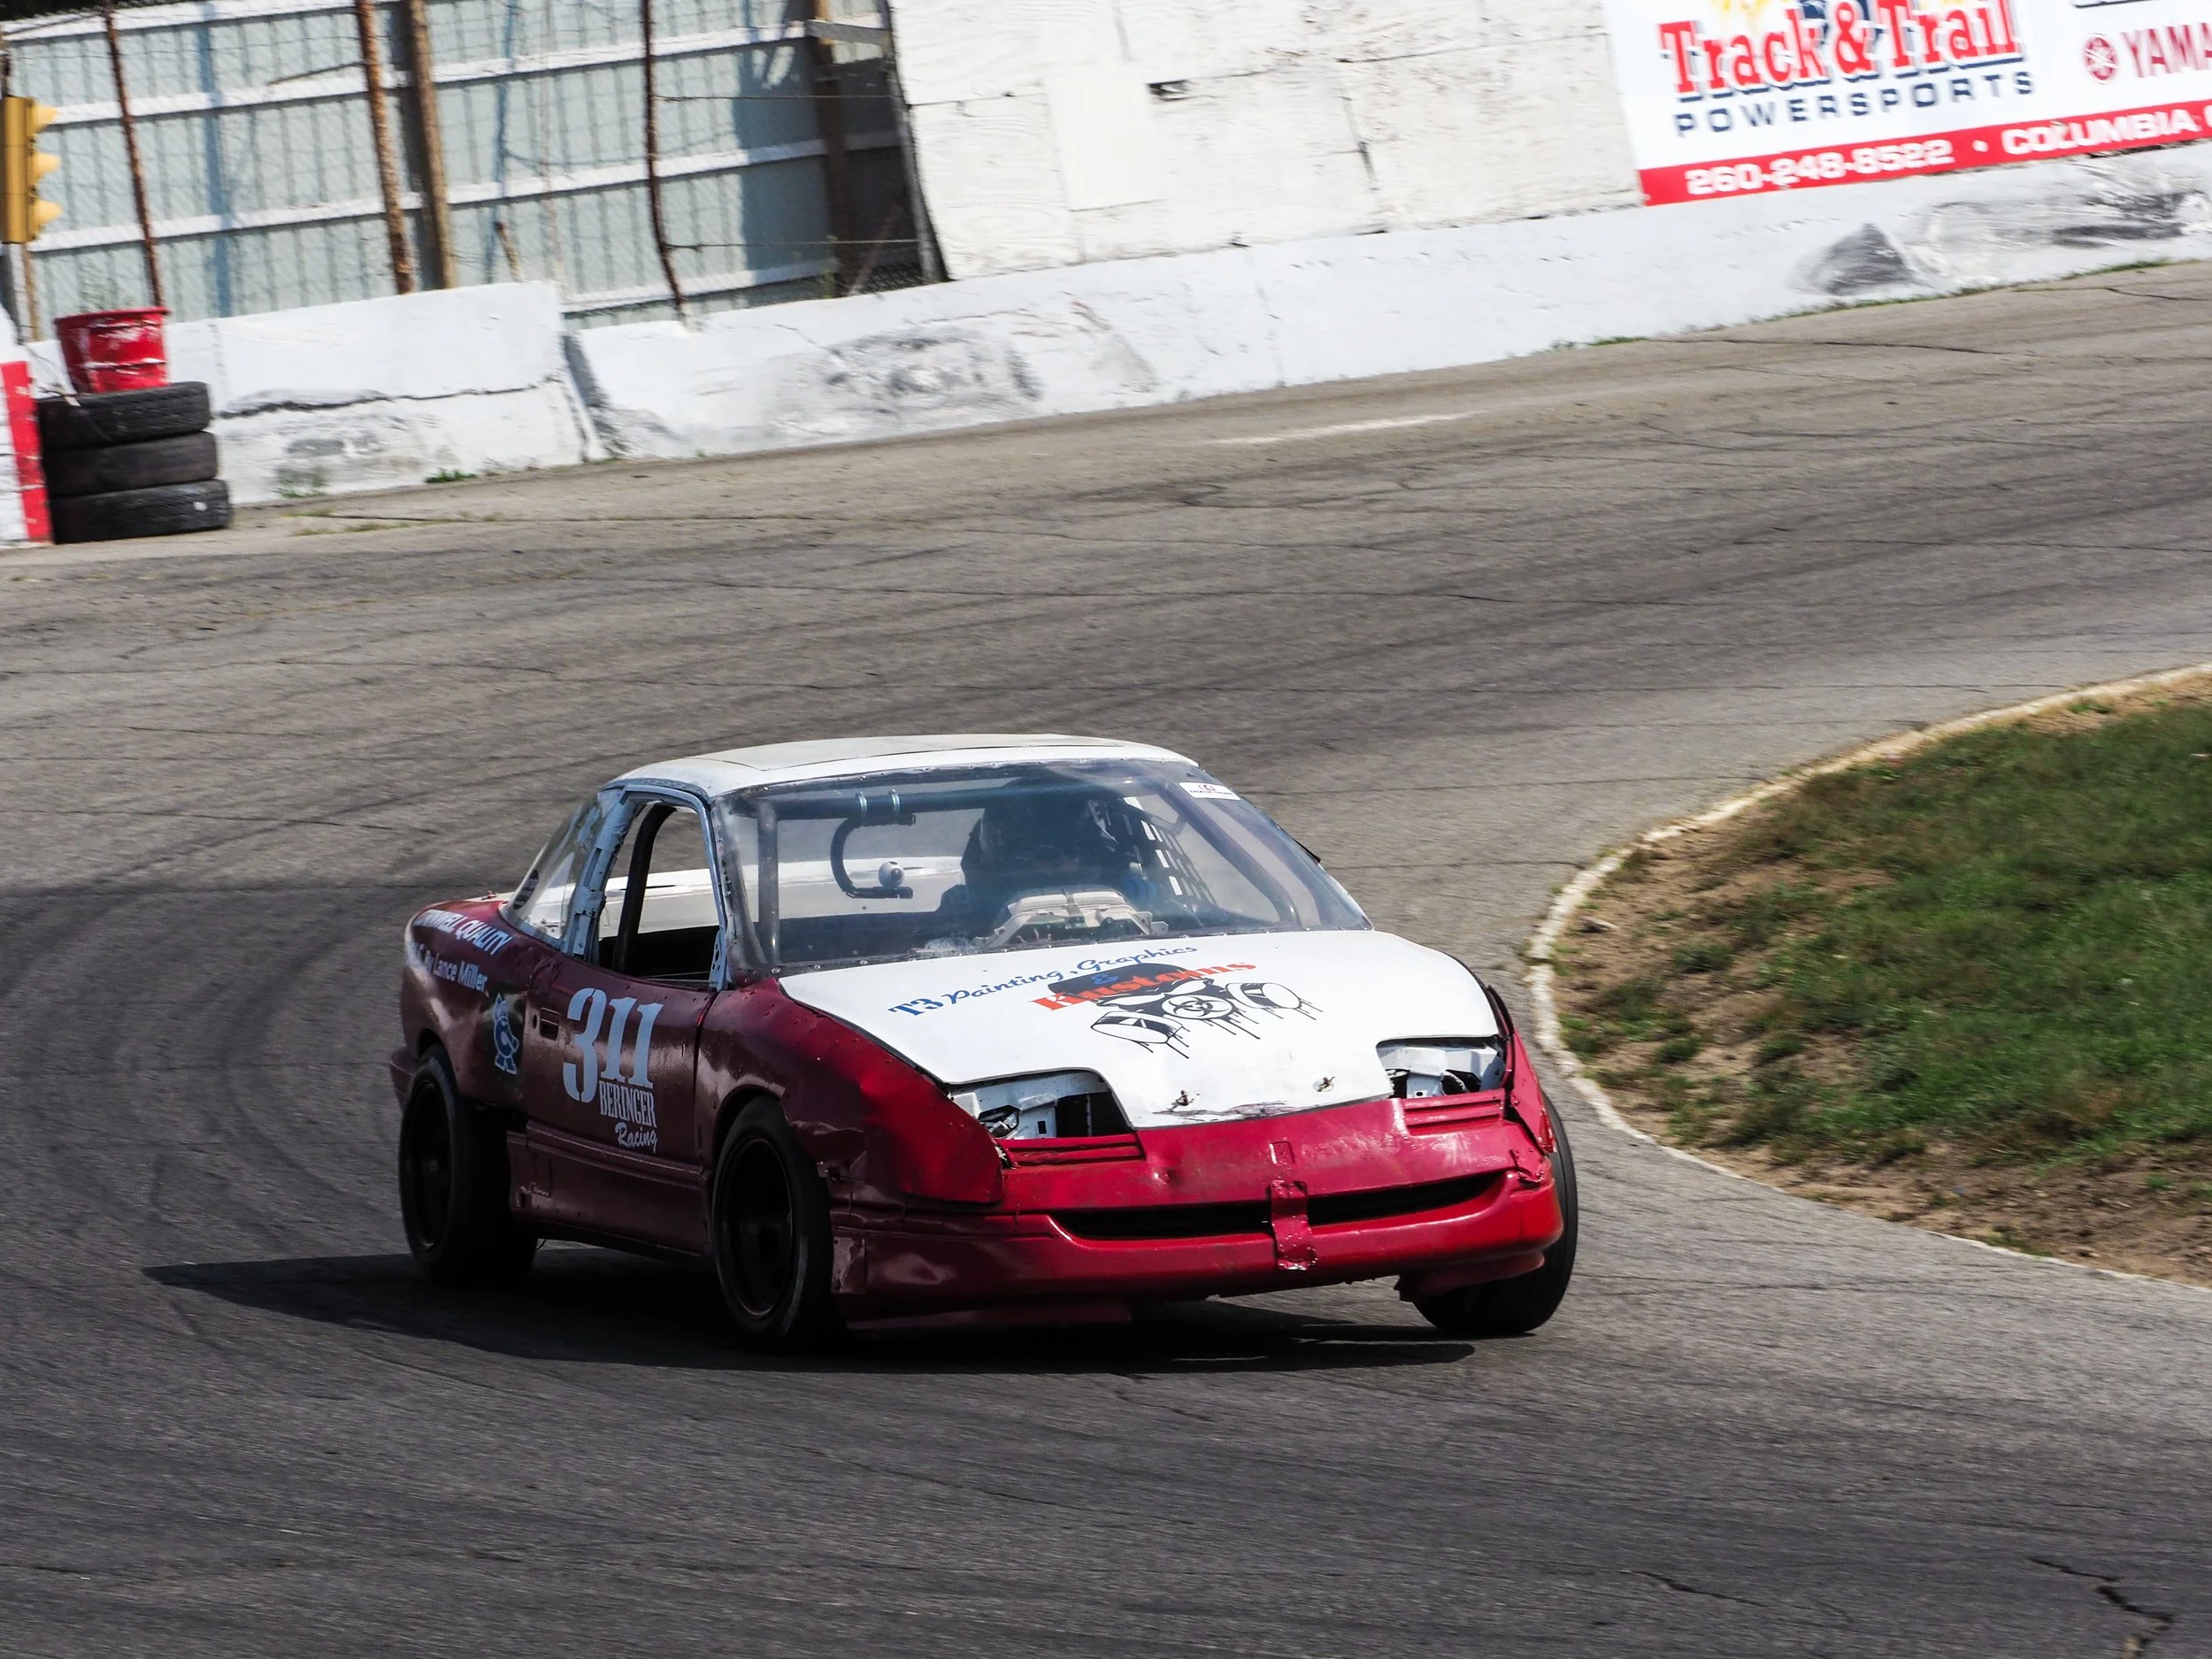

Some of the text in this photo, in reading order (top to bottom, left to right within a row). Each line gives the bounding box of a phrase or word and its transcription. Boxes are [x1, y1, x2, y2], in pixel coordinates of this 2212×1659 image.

[1675, 72, 2034, 138] POWERSPORTS
[1685, 139, 1955, 196] 260-248-8522
[2001, 109, 2202, 155] COLUMBIA
[455, 919, 513, 956] QUALITY
[433, 953, 458, 982] Lance
[457, 960, 488, 992] Miller
[887, 998, 944, 1016] T3
[563, 987, 664, 1103] 311
[599, 1079, 658, 1128] BERINGER
[615, 1121, 659, 1154] Racing
